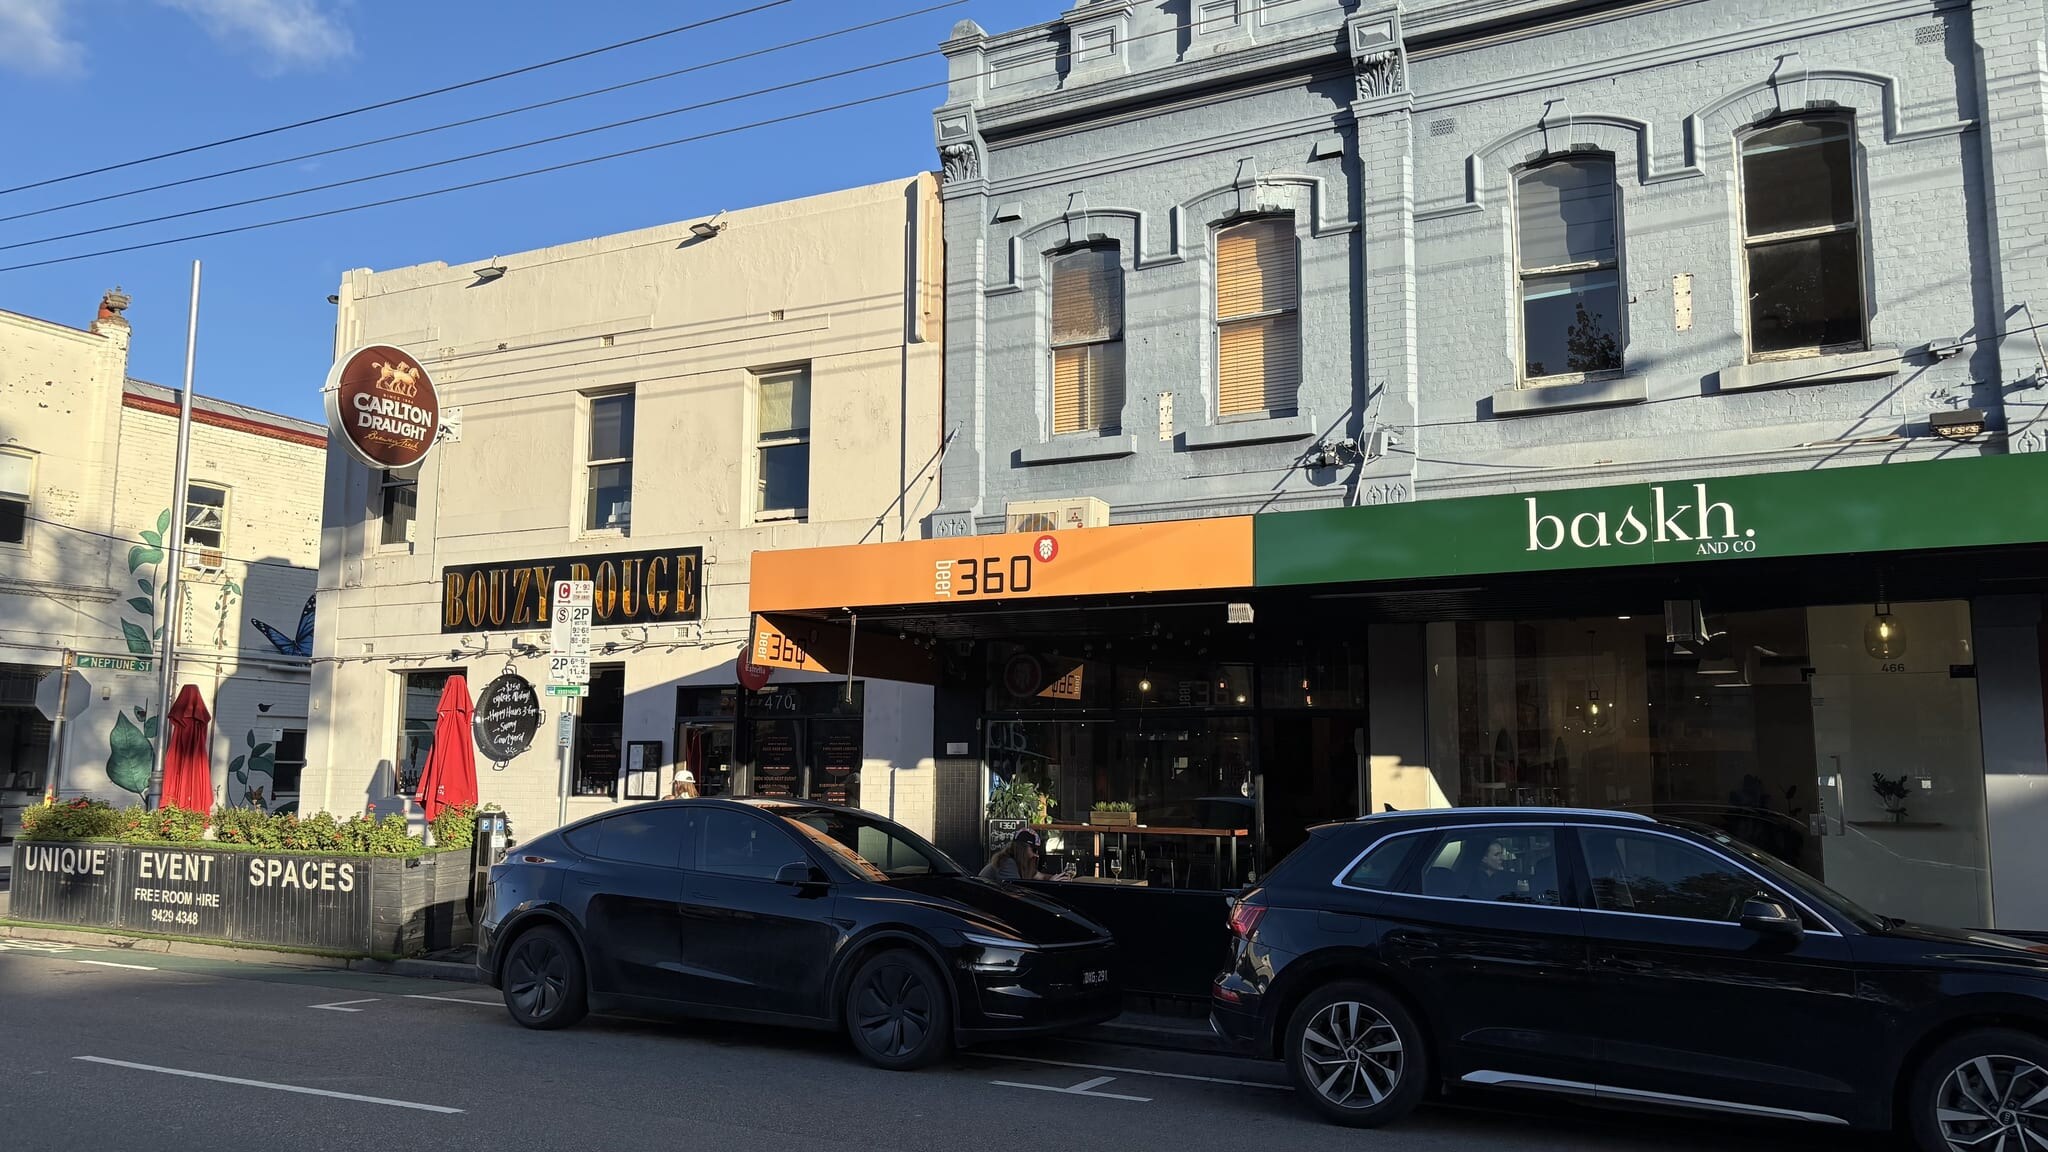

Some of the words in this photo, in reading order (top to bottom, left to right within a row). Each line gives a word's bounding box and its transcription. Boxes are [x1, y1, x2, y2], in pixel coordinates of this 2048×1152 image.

[354, 393, 432, 427] CARLTON
[358, 412, 427, 441] DRAUGHT
[1525, 484, 1755, 551] baskh.
[1696, 542, 1729, 555] AND
[1733, 540, 1756, 552] CO
[935, 559, 957, 598] beer
[957, 555, 1031, 595] 360
[444, 566, 555, 627] BOUZY
[559, 583, 570, 598] C
[573, 608, 589, 620] 2P
[757, 632, 771, 660] beer
[90, 657, 136, 670] NEPTUNE
[138, 661, 151, 671] ST
[551, 658, 568, 670] 2P
[1881, 663, 1905, 672] 466
[764, 694, 793, 709] 470
[489, 708, 506, 722] Happy
[25, 846, 106, 875] UNIQUE
[140, 852, 215, 882] EVENT
[250, 858, 355, 892] SPACES
[134, 887, 160, 902] FREE
[161, 890, 193, 905] ROOM
[195, 893, 220, 907] HIRE
[151, 908, 174, 922] 9429
[175, 910, 199, 925] 4348
